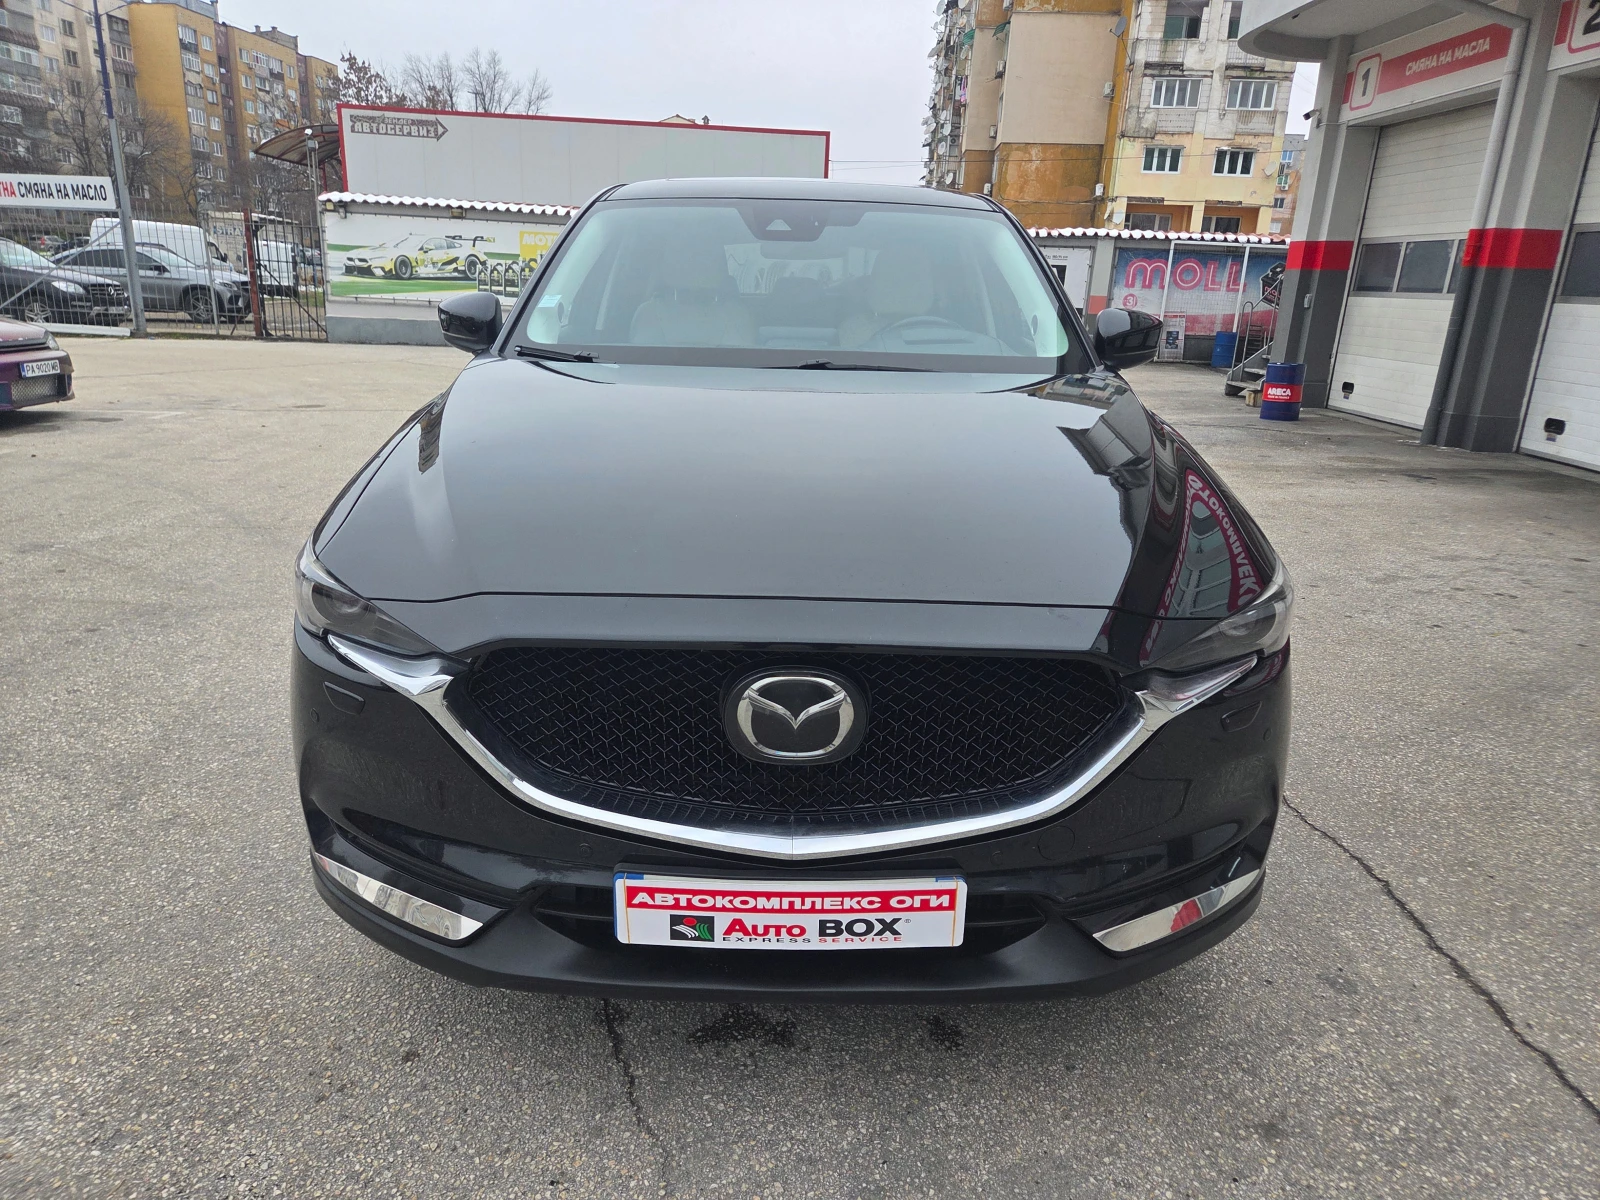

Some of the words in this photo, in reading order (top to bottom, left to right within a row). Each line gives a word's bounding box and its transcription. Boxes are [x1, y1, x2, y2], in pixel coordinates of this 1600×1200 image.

[1405, 53, 1438, 76] СМЯНА
[1438, 49, 1453, 66] НА
[1453, 38, 1491, 61] МАСЛА
[1361, 67, 1372, 97] 1
[354, 122, 435, 137] АВТОСЕРВИЗ
[17, 181, 55, 199] СМЯНА
[55, 183, 71, 200] НА
[70, 184, 108, 202] МАСЛО
[1267, 387, 1291, 396] ARECA
[631, 892, 882, 910] АВТОКОМПЛЕКС
[889, 894, 951, 909] ОГИ
